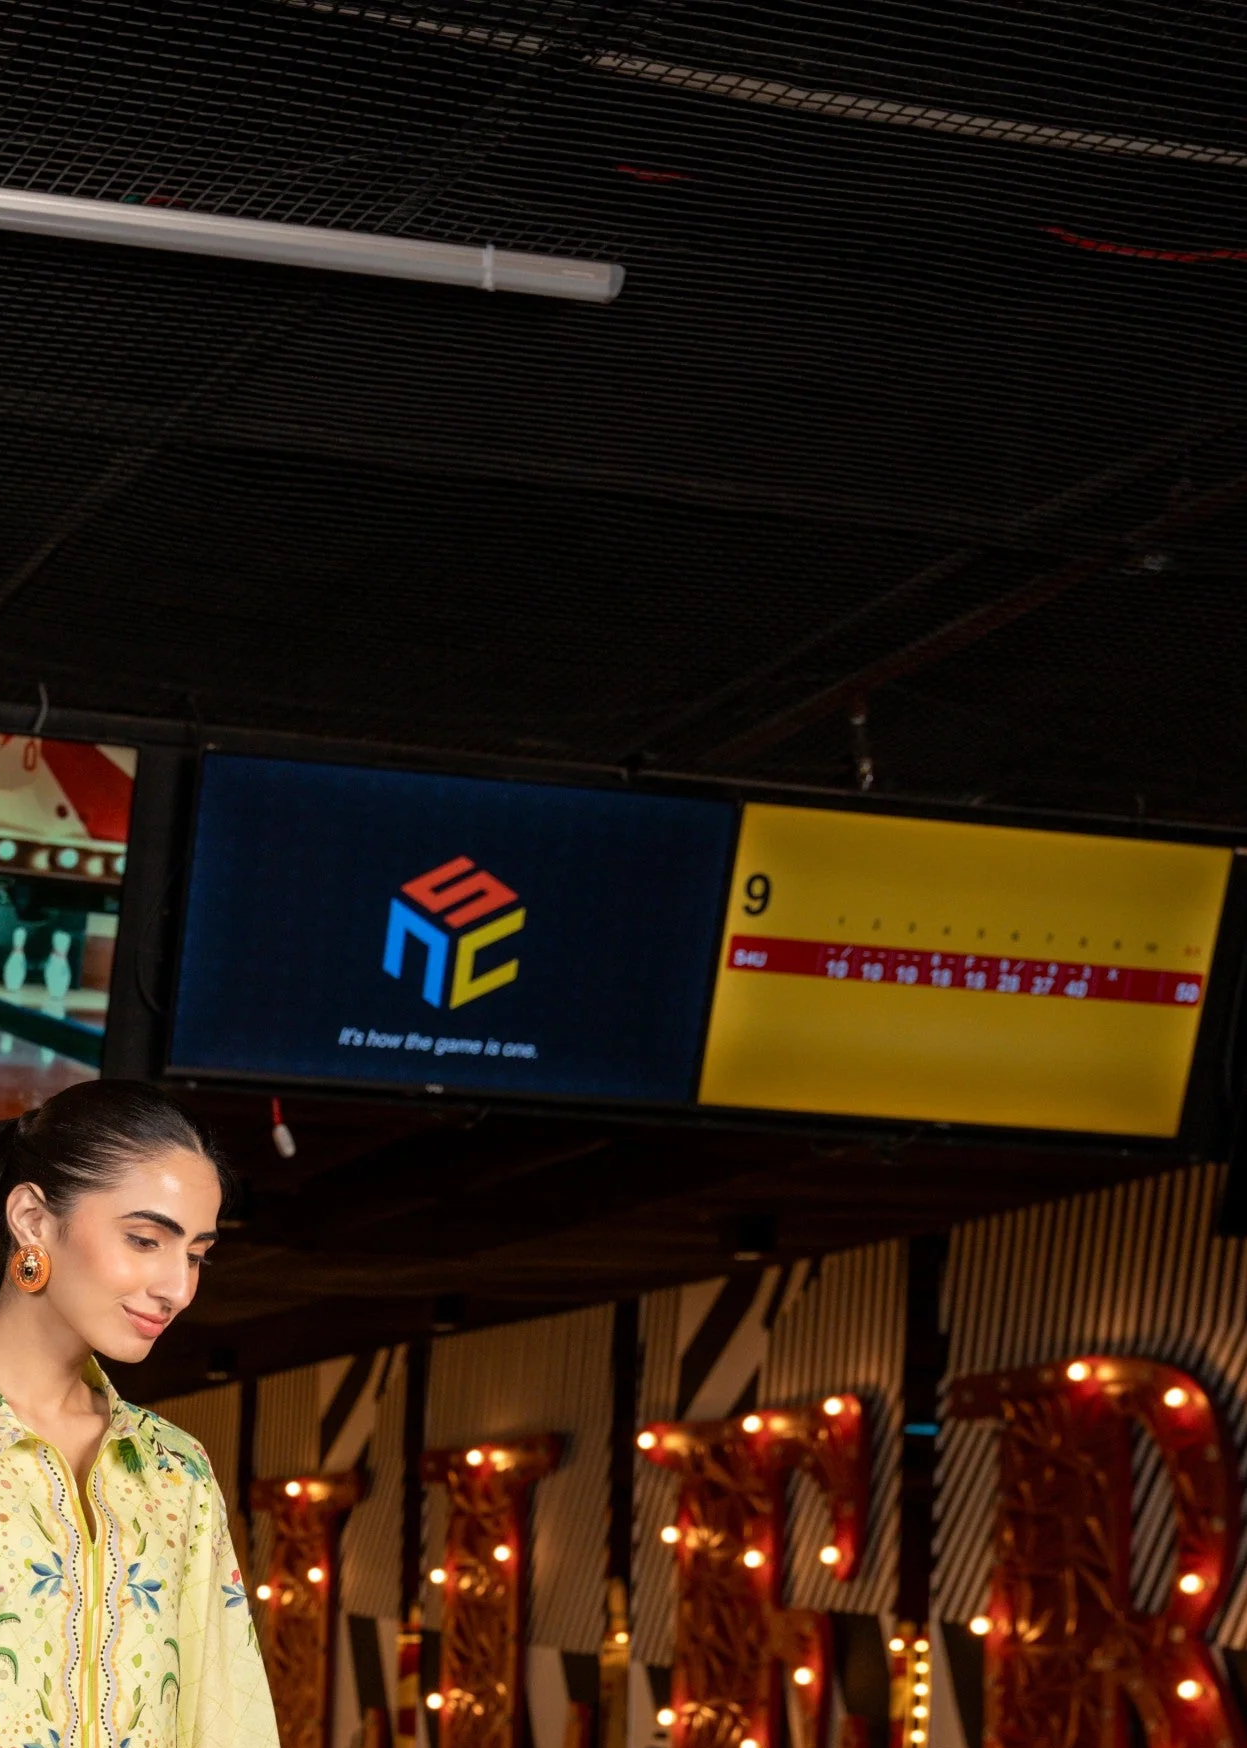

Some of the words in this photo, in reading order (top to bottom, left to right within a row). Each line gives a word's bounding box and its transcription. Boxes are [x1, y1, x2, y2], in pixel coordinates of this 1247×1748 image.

[743, 872, 771, 916] 9
[338, 1027, 364, 1047] It's
[365, 1029, 404, 1048] how
[405, 1032, 434, 1051] the
[434, 1037, 483, 1056] game
[484, 1038, 501, 1056] is
[502, 1041, 539, 1059] one.
